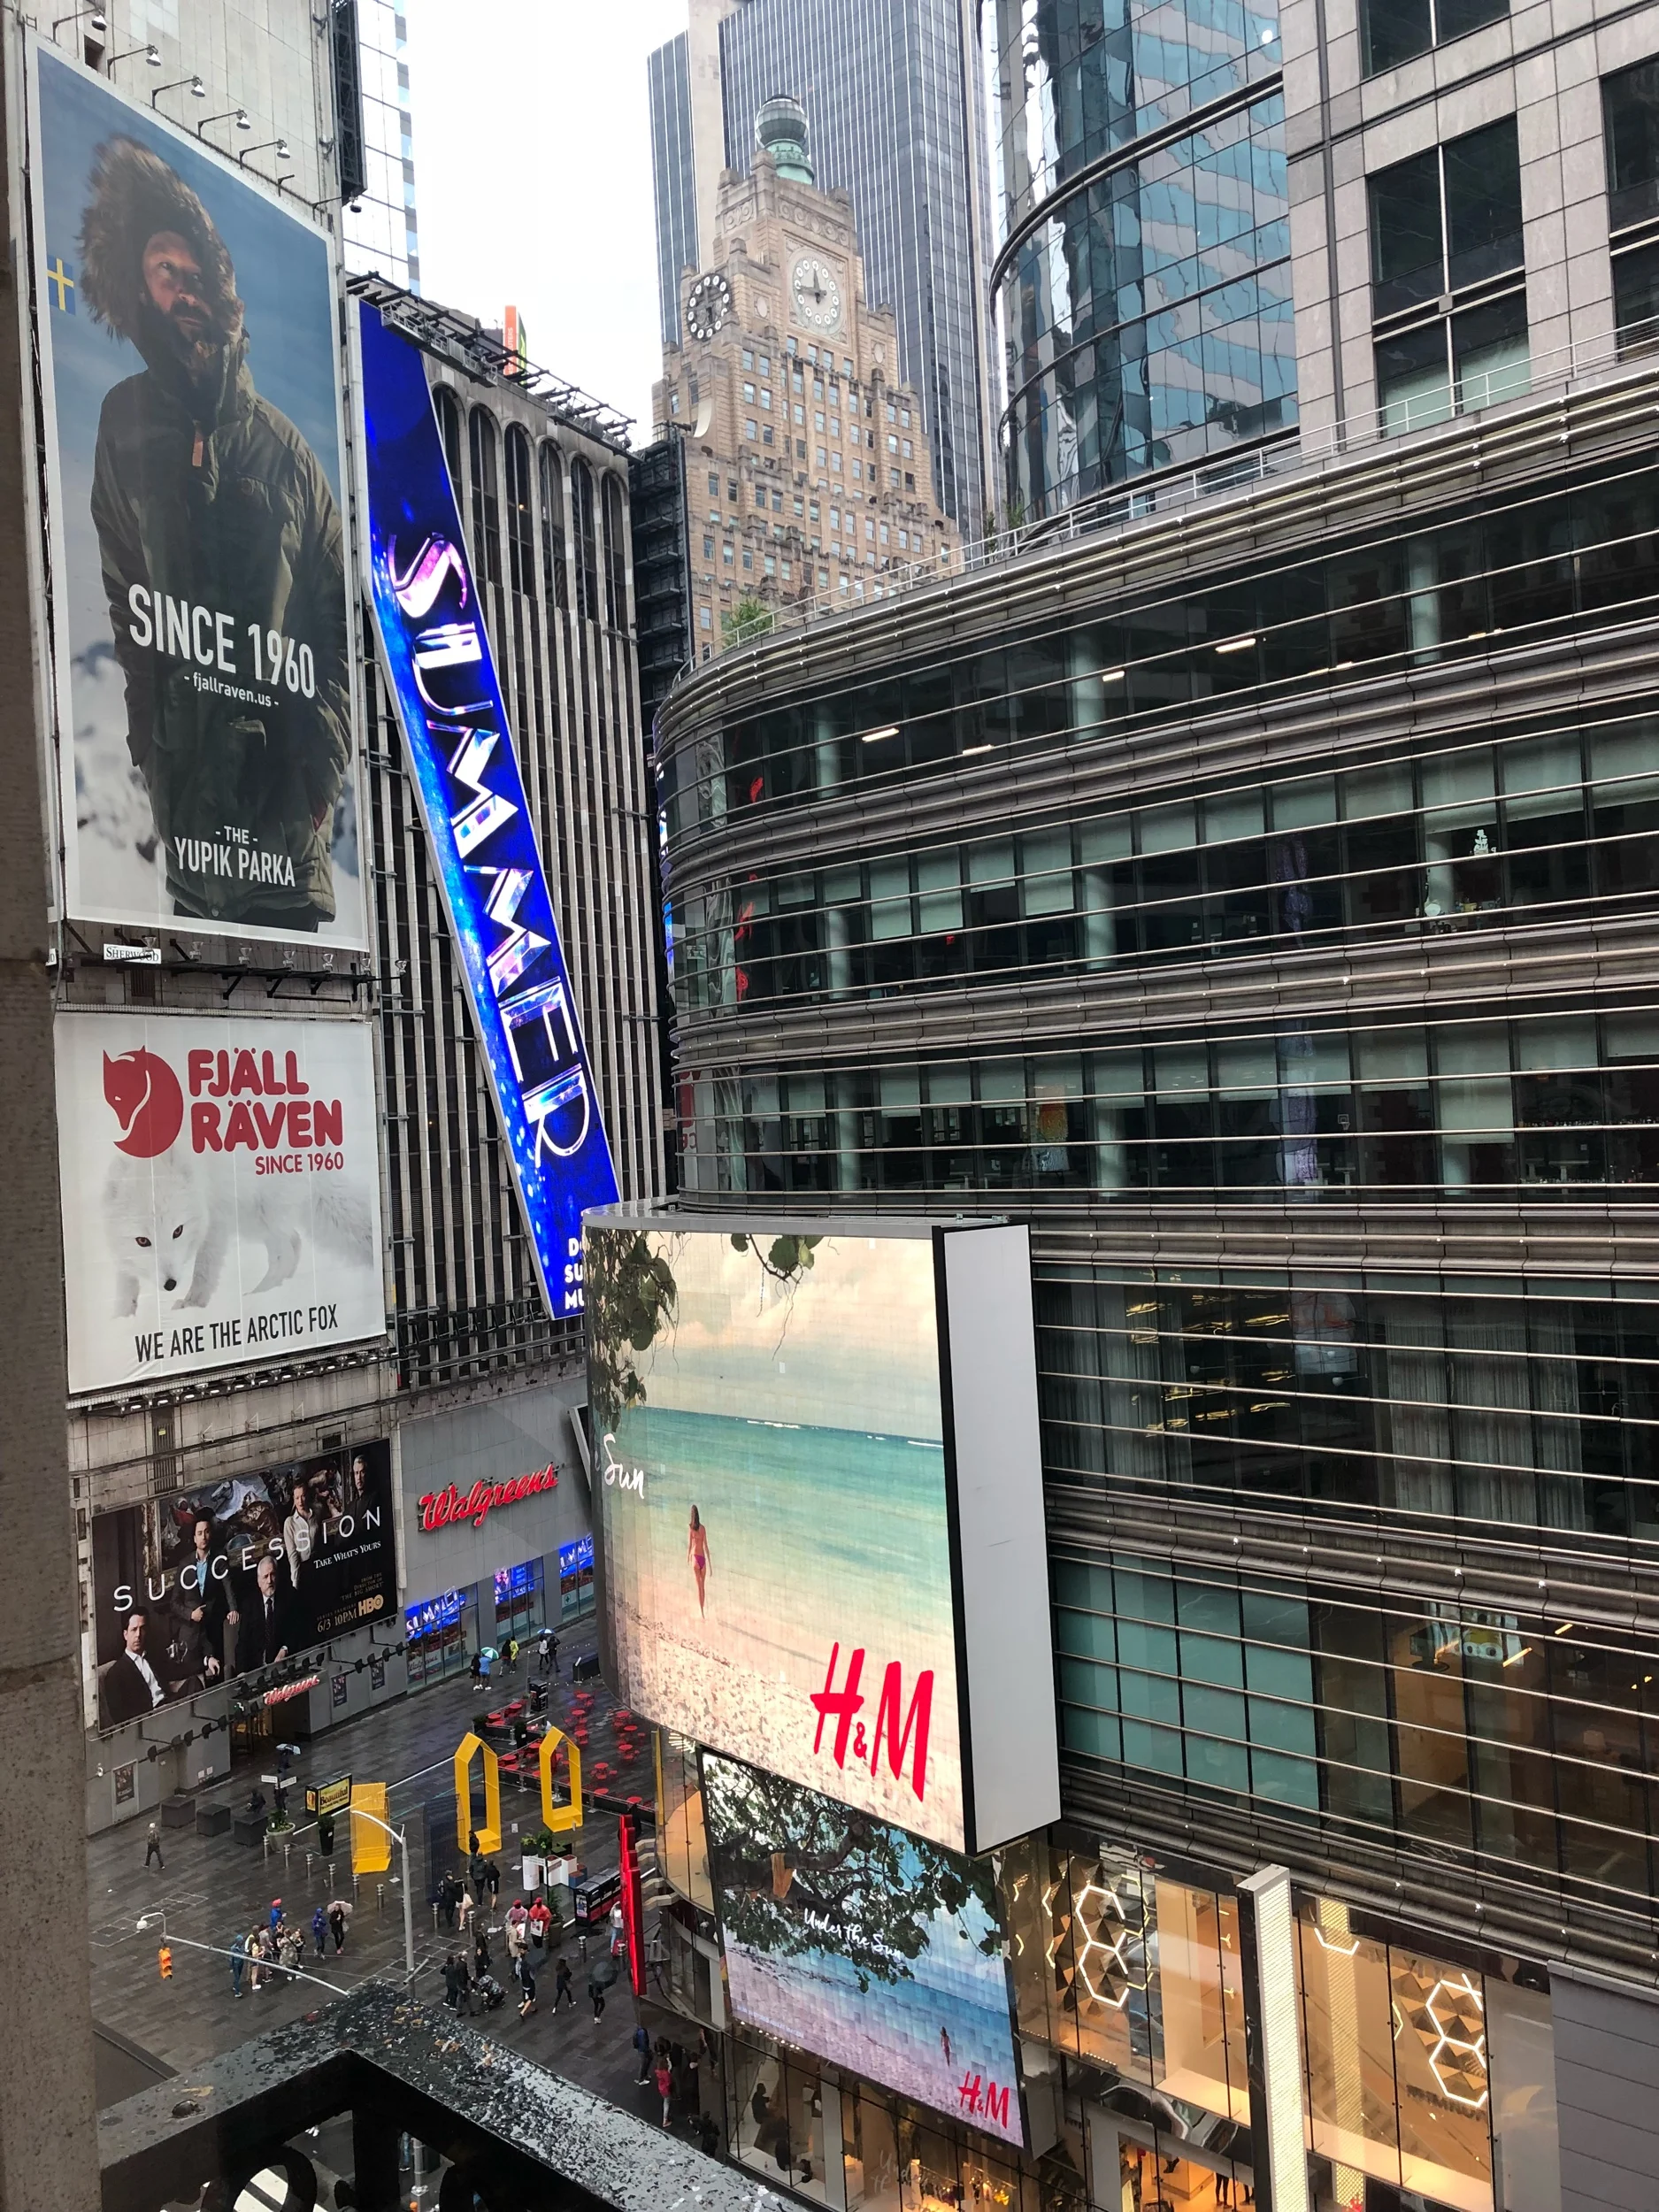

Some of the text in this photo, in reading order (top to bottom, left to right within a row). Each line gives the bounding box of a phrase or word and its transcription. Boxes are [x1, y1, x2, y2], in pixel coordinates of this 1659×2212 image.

[128, 584, 315, 698] SINCE 1960
[174, 836, 296, 887] YUPIK PARKA
[224, 826, 250, 845] THE
[388, 533, 590, 1169] SUMMER
[188, 1047, 309, 1097] FJÄLL
[190, 1099, 343, 1154] RÄVEN
[255, 1152, 344, 1175] SINCE 1960
[134, 1303, 338, 1363] WE ARE THE ARCTIC FOX
[603, 1432, 644, 1500] Sun
[419, 1463, 558, 1531] Walgreens
[113, 1506, 380, 1612] SUCCESSION
[317, 1608, 357, 1632] 6/3 10PM
[357, 1594, 384, 1617] HBO
[263, 1675, 320, 1705] Walgreens
[810, 1641, 934, 1802] H&M
[804, 1907, 902, 1961] Under the Sun
[957, 2070, 1010, 2129] H&M
